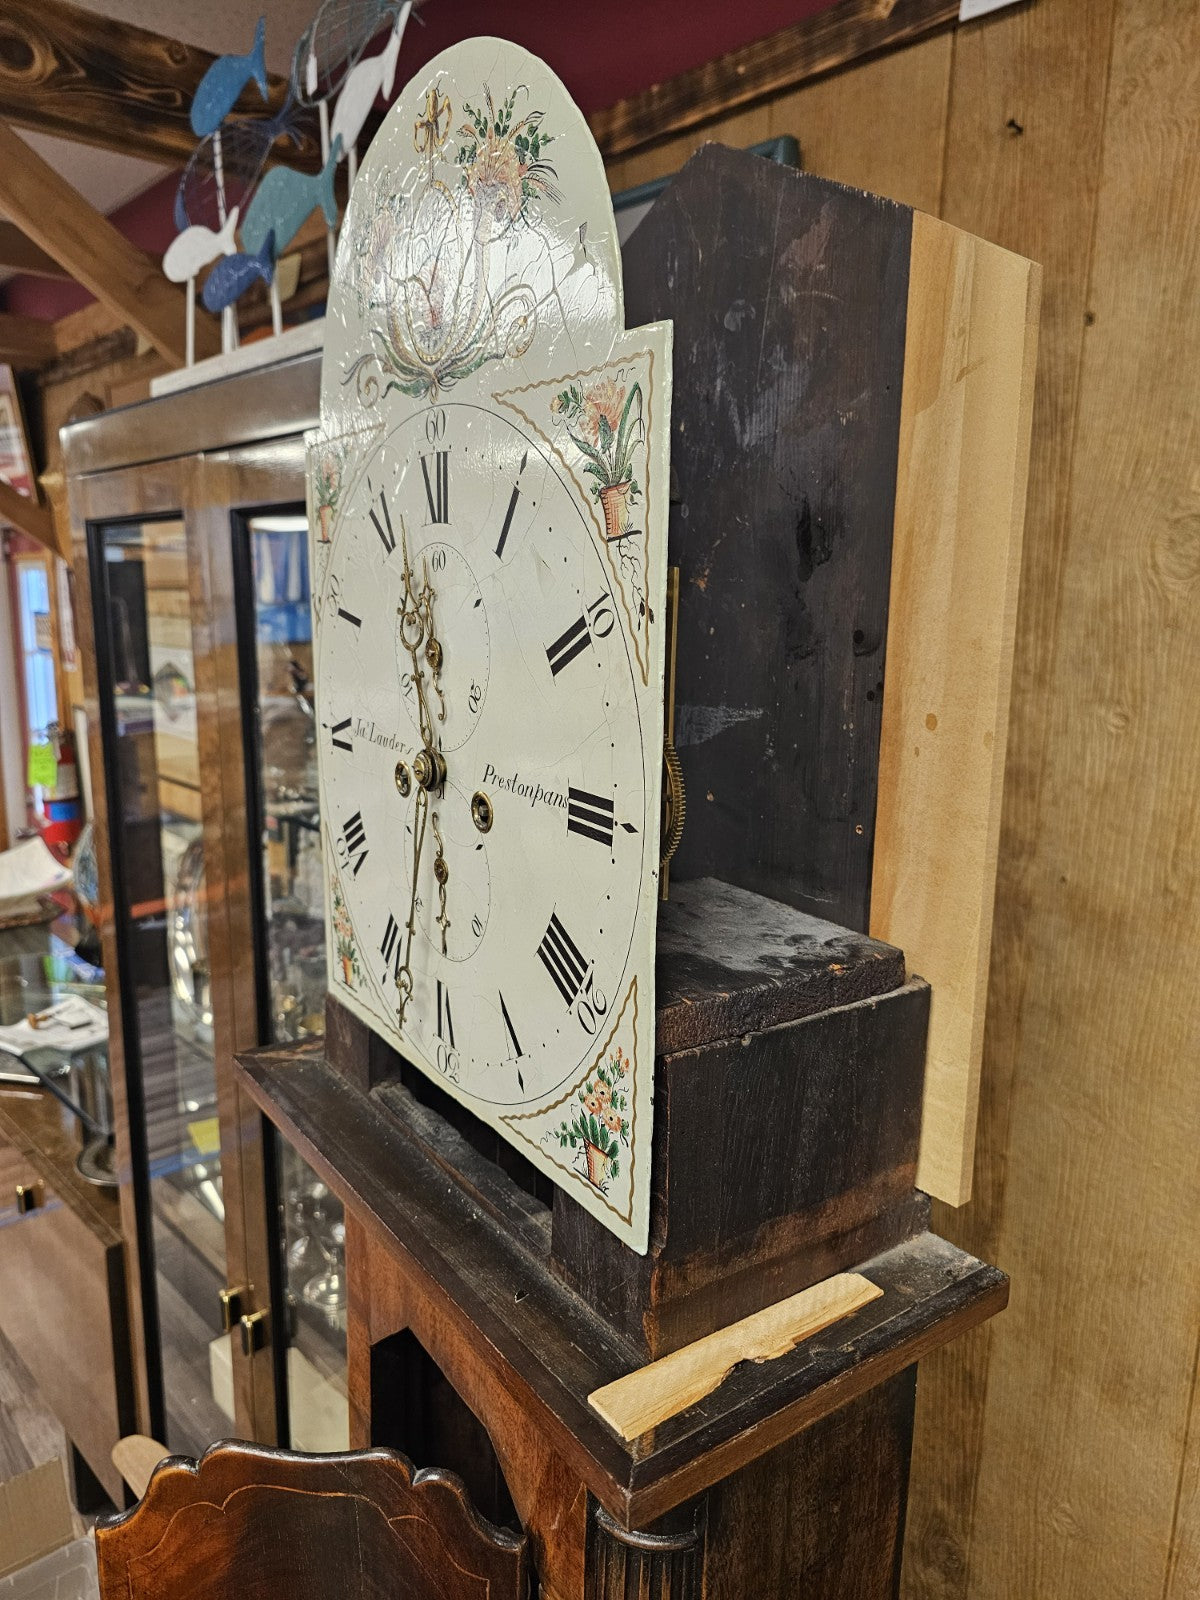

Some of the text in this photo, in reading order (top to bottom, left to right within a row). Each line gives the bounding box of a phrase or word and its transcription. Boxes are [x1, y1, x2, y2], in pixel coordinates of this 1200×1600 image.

[425, 408, 447, 445] 60
[431, 548, 446, 573] 60
[586, 586, 615, 638] 10
[543, 610, 594, 687] II
[482, 763, 569, 808] Prestonpans
[567, 778, 614, 854] III
[534, 902, 593, 1013] IIII
[577, 970, 607, 1035] 20
[437, 1044, 460, 1084] 30
